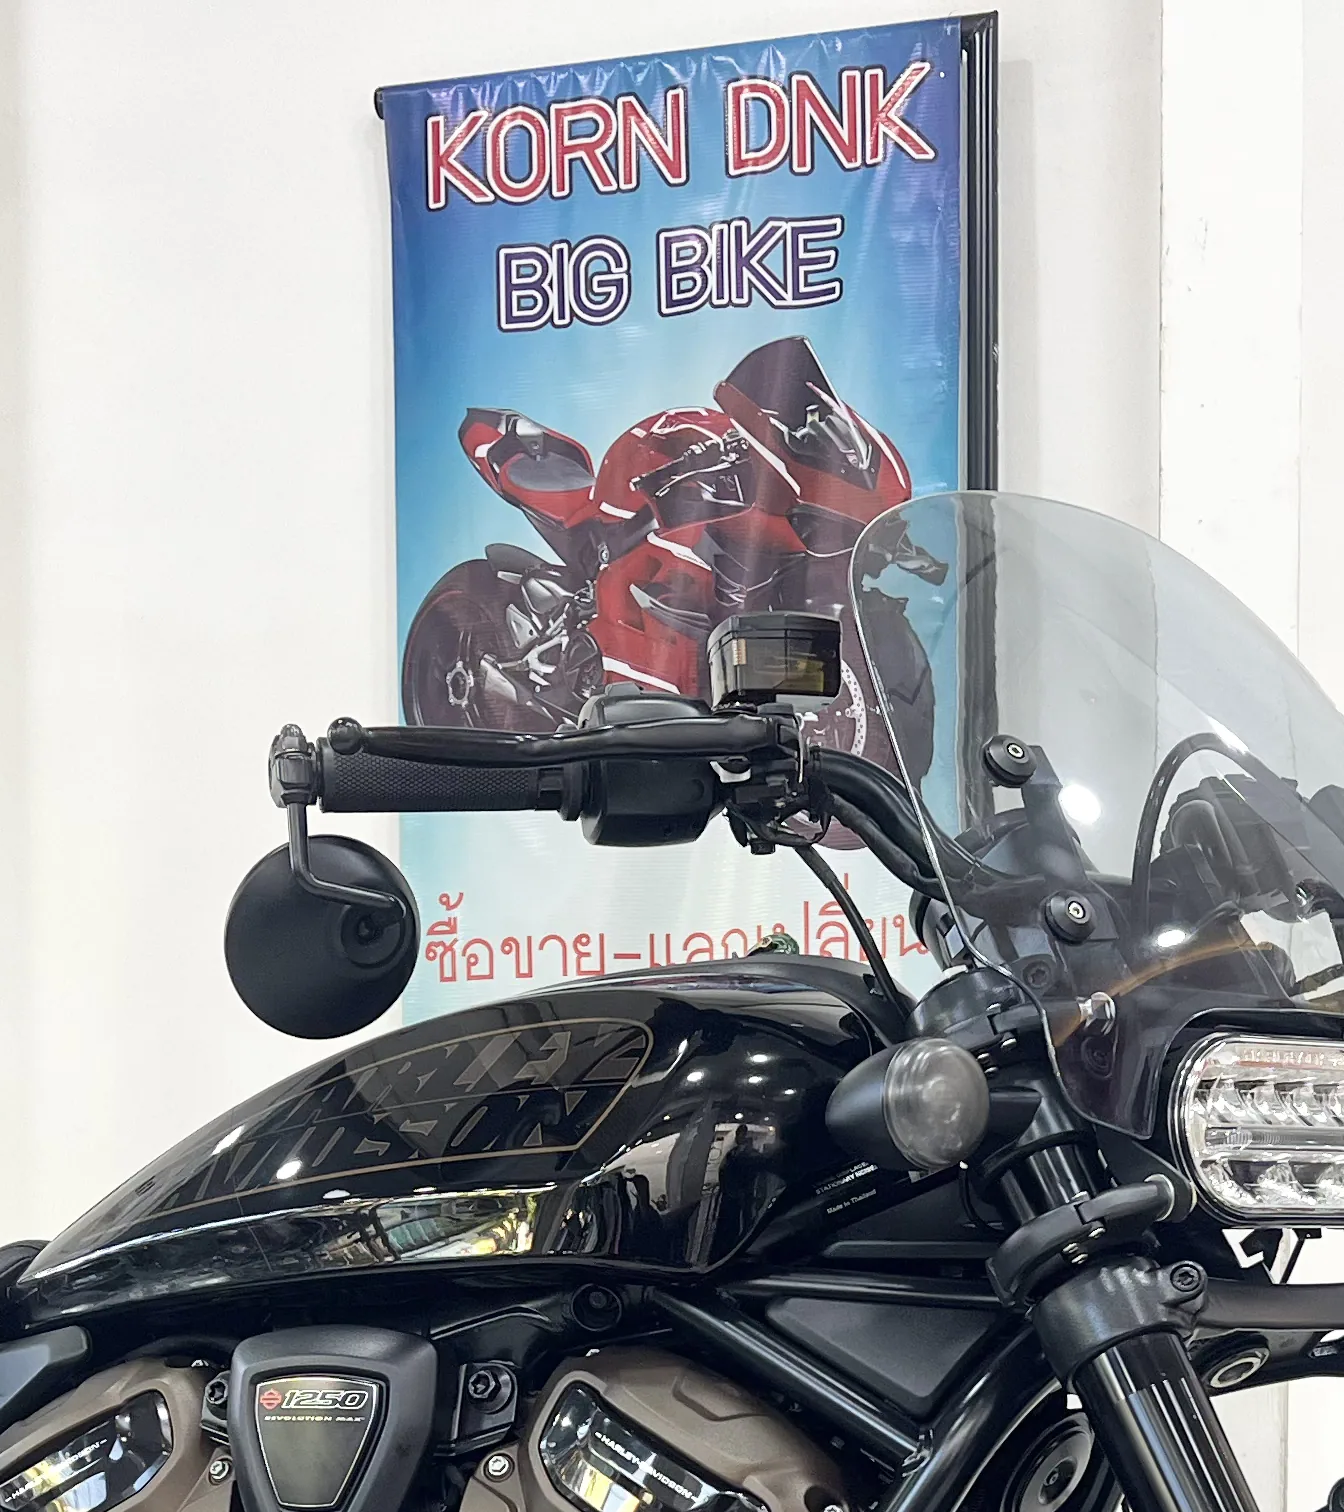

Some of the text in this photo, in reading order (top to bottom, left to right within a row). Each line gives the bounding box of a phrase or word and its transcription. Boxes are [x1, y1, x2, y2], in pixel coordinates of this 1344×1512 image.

[425, 60, 937, 210] KORN DNK
[494, 214, 845, 332] BIG BIKE
[281, 1389, 369, 1410] 1250
